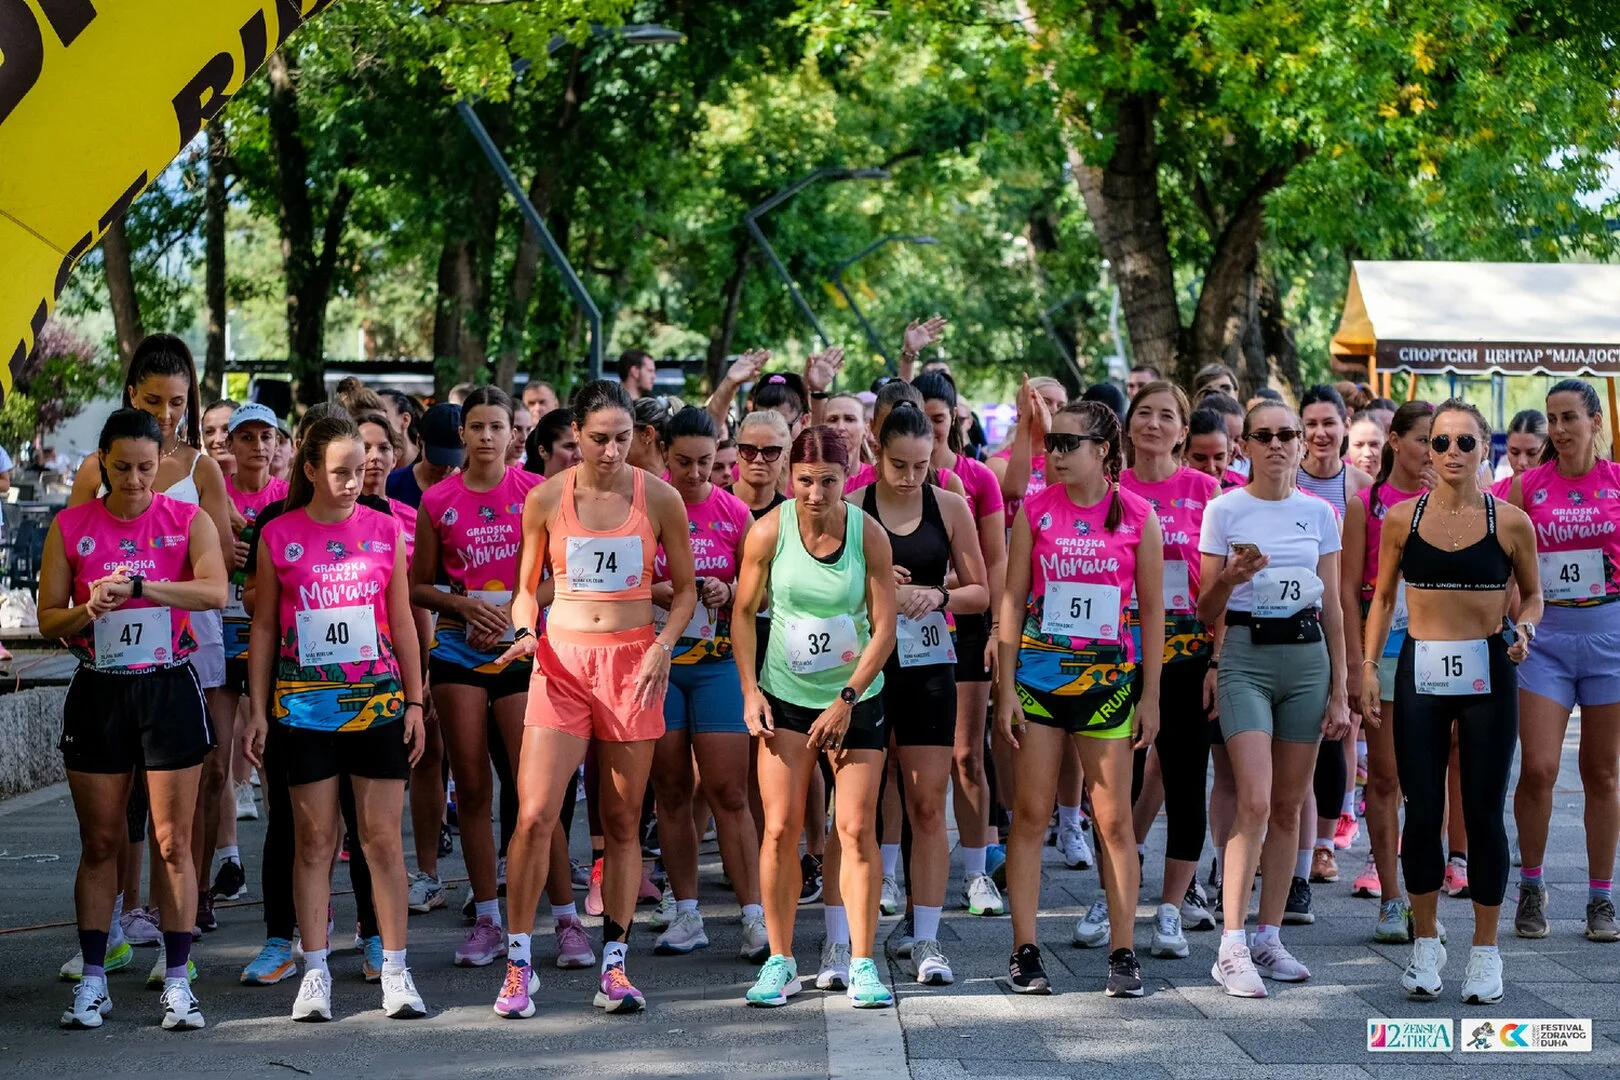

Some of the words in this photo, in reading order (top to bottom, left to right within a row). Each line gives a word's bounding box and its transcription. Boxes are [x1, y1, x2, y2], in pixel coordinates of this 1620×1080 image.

[1399, 347, 1478, 363] СПОРТСКИ
[1485, 348, 1544, 364] ЦЕНТАР
[1551, 507, 1600, 517] GRADSKA
[1558, 513, 1592, 524] PLAŽA
[466, 524, 513, 537] GRADSKA
[474, 533, 506, 545] PLAŽA
[1537, 520, 1616, 547] Morava
[1055, 537, 1106, 549] GRADSKA
[1062, 545, 1096, 557] PLAŽA
[456, 541, 521, 572] Morav
[593, 551, 618, 574] 74
[1040, 552, 1120, 582] Morava
[312, 562, 367, 574] GRADSKA
[322, 569, 359, 582] PLAŽA
[1559, 563, 1581, 584] 43
[299, 578, 381, 611] Morava
[1279, 580, 1301, 602] 73
[1069, 597, 1092, 620] 51
[119, 622, 143, 646] 47
[325, 621, 349, 645] 40
[807, 632, 831, 656] 32
[920, 624, 941, 648] 30
[1441, 655, 1463, 678] 15
